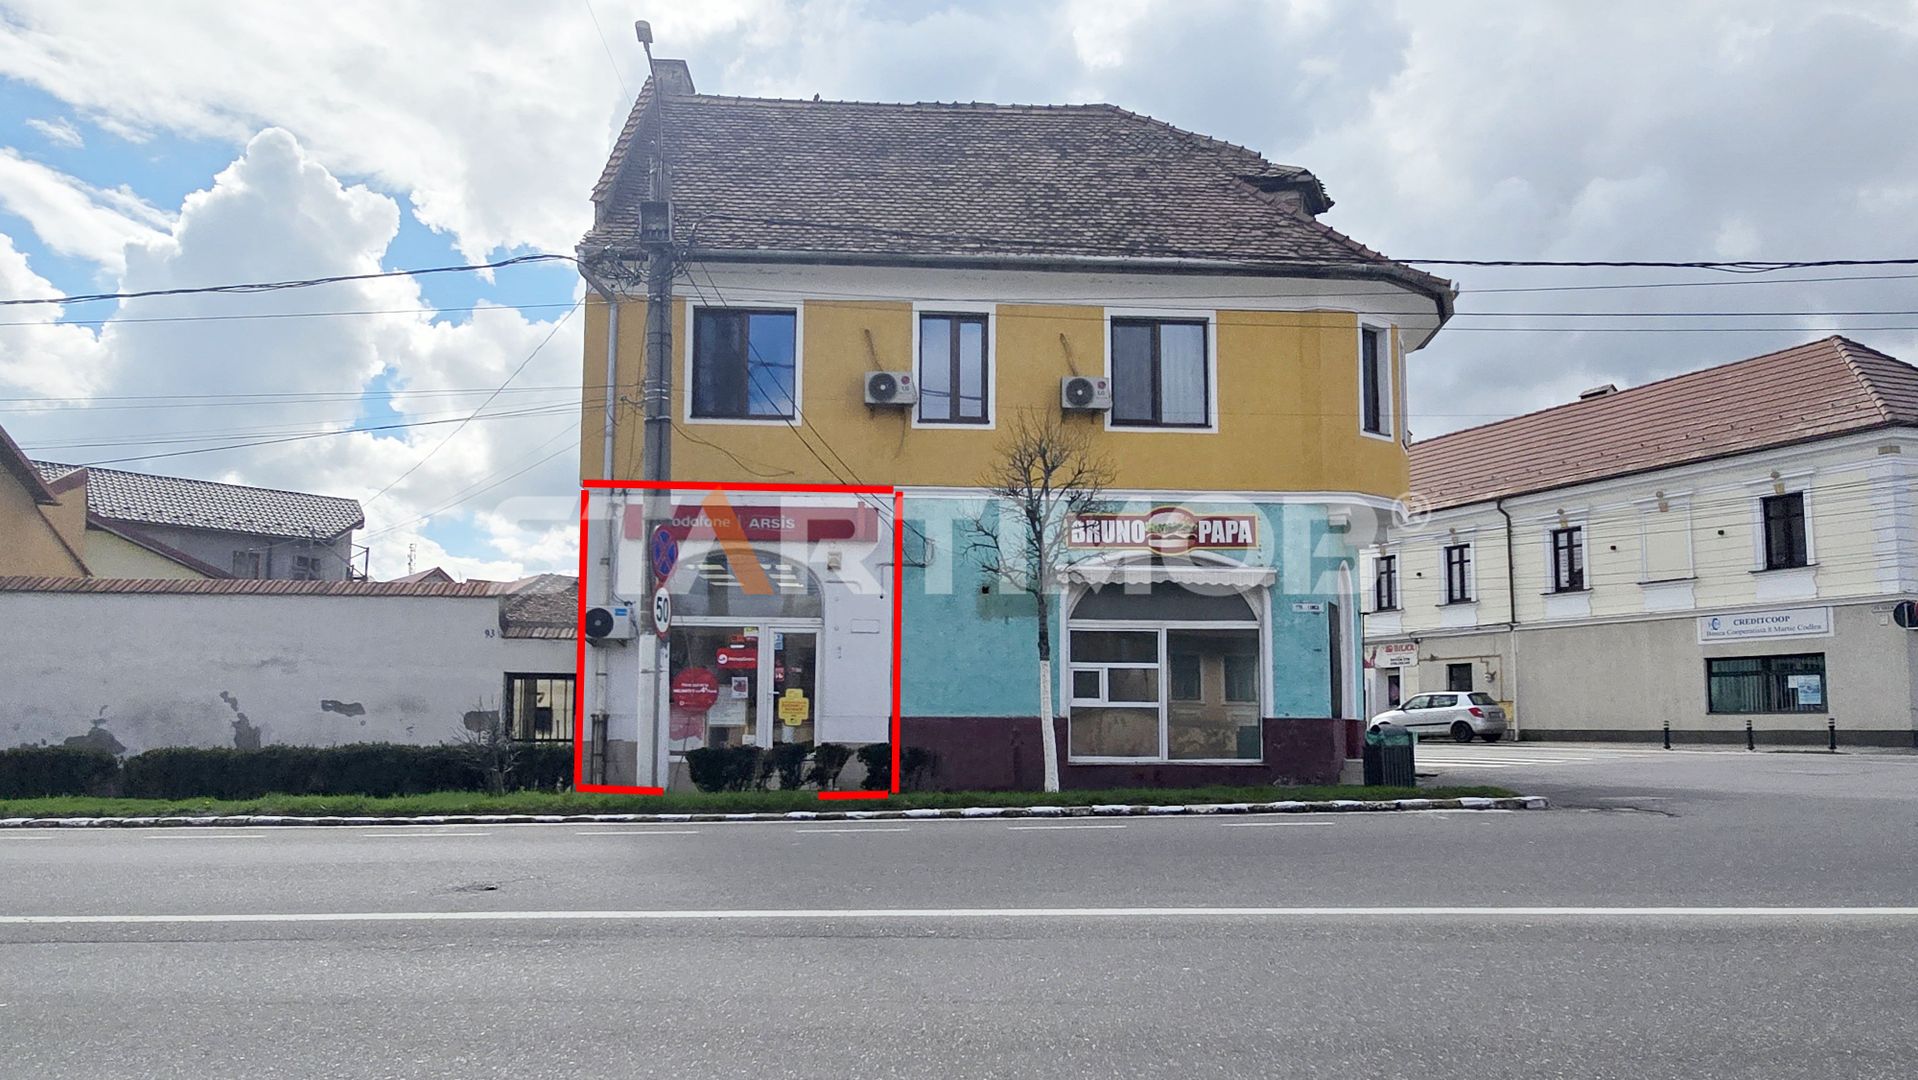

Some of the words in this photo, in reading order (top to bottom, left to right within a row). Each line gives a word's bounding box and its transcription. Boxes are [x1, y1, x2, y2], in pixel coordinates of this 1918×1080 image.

[671, 514, 731, 528] odafone
[1071, 519, 1146, 544] BRUNO
[1198, 519, 1253, 544] PAPA
[656, 596, 669, 623] 50
